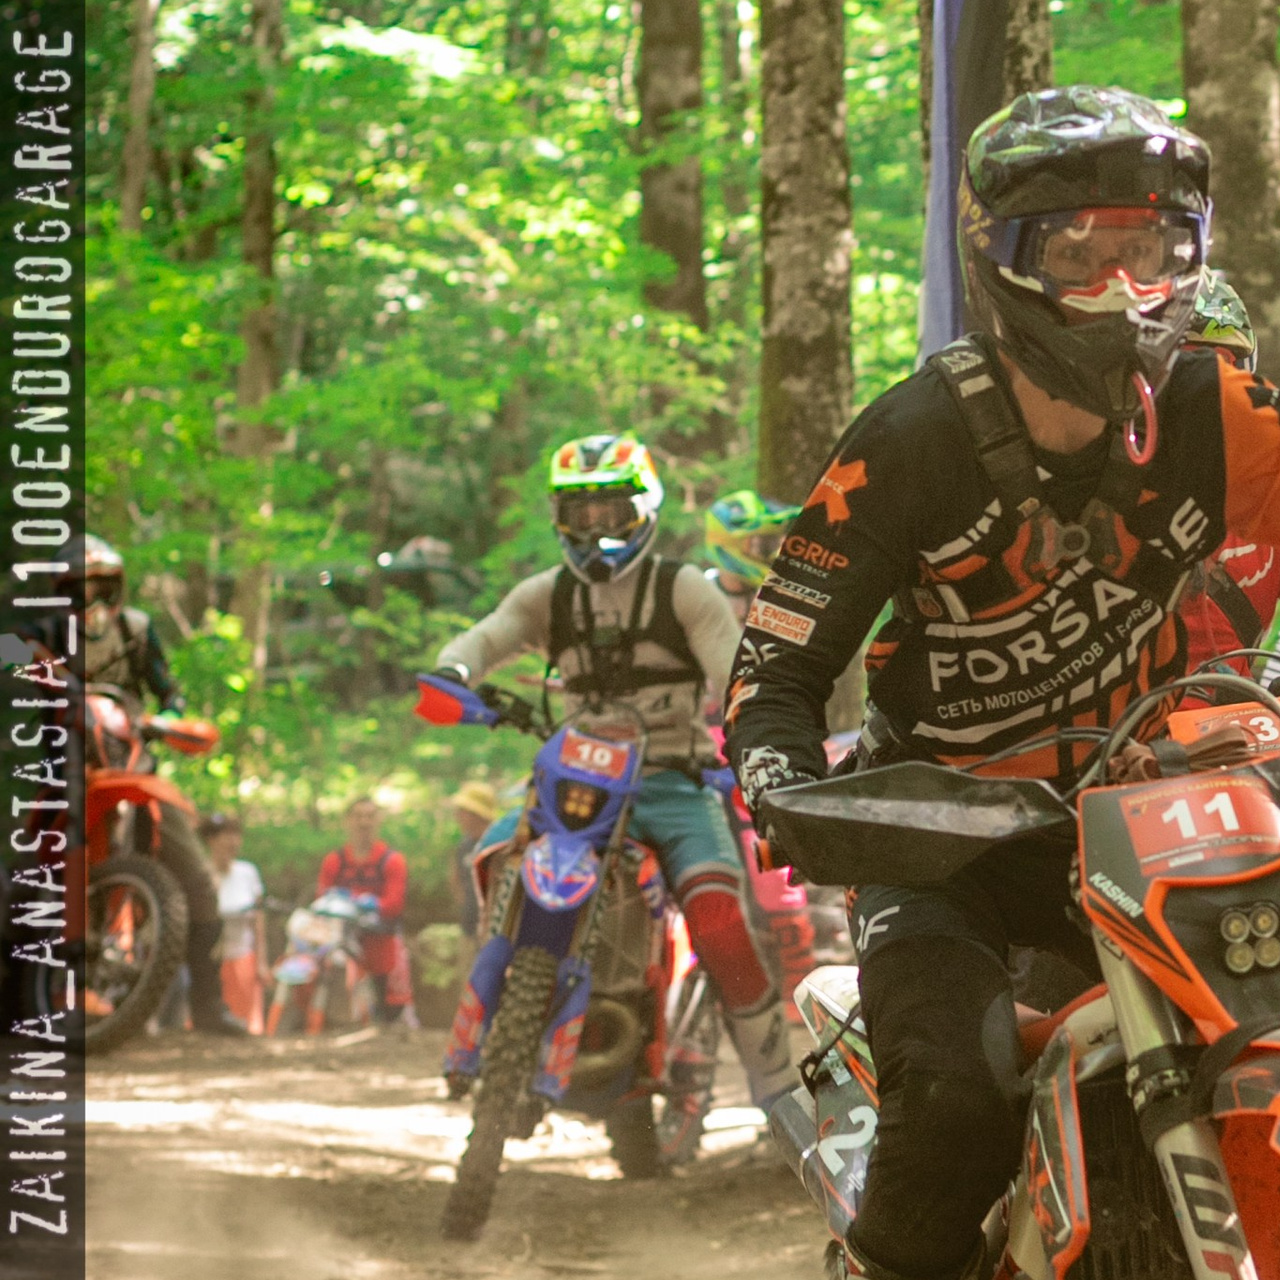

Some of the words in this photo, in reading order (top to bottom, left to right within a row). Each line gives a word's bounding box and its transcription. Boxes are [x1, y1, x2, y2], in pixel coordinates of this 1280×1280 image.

[761, 605, 811, 632] ENDURO
[761, 619, 809, 642] ELEMENT
[937, 696, 983, 719] СЕТЬ
[986, 640, 1104, 711] МОТОЦЕНТРОВ
[576, 742, 613, 767] 10
[1161, 791, 1240, 840] 11
[1089, 872, 1144, 918] KASHIN
